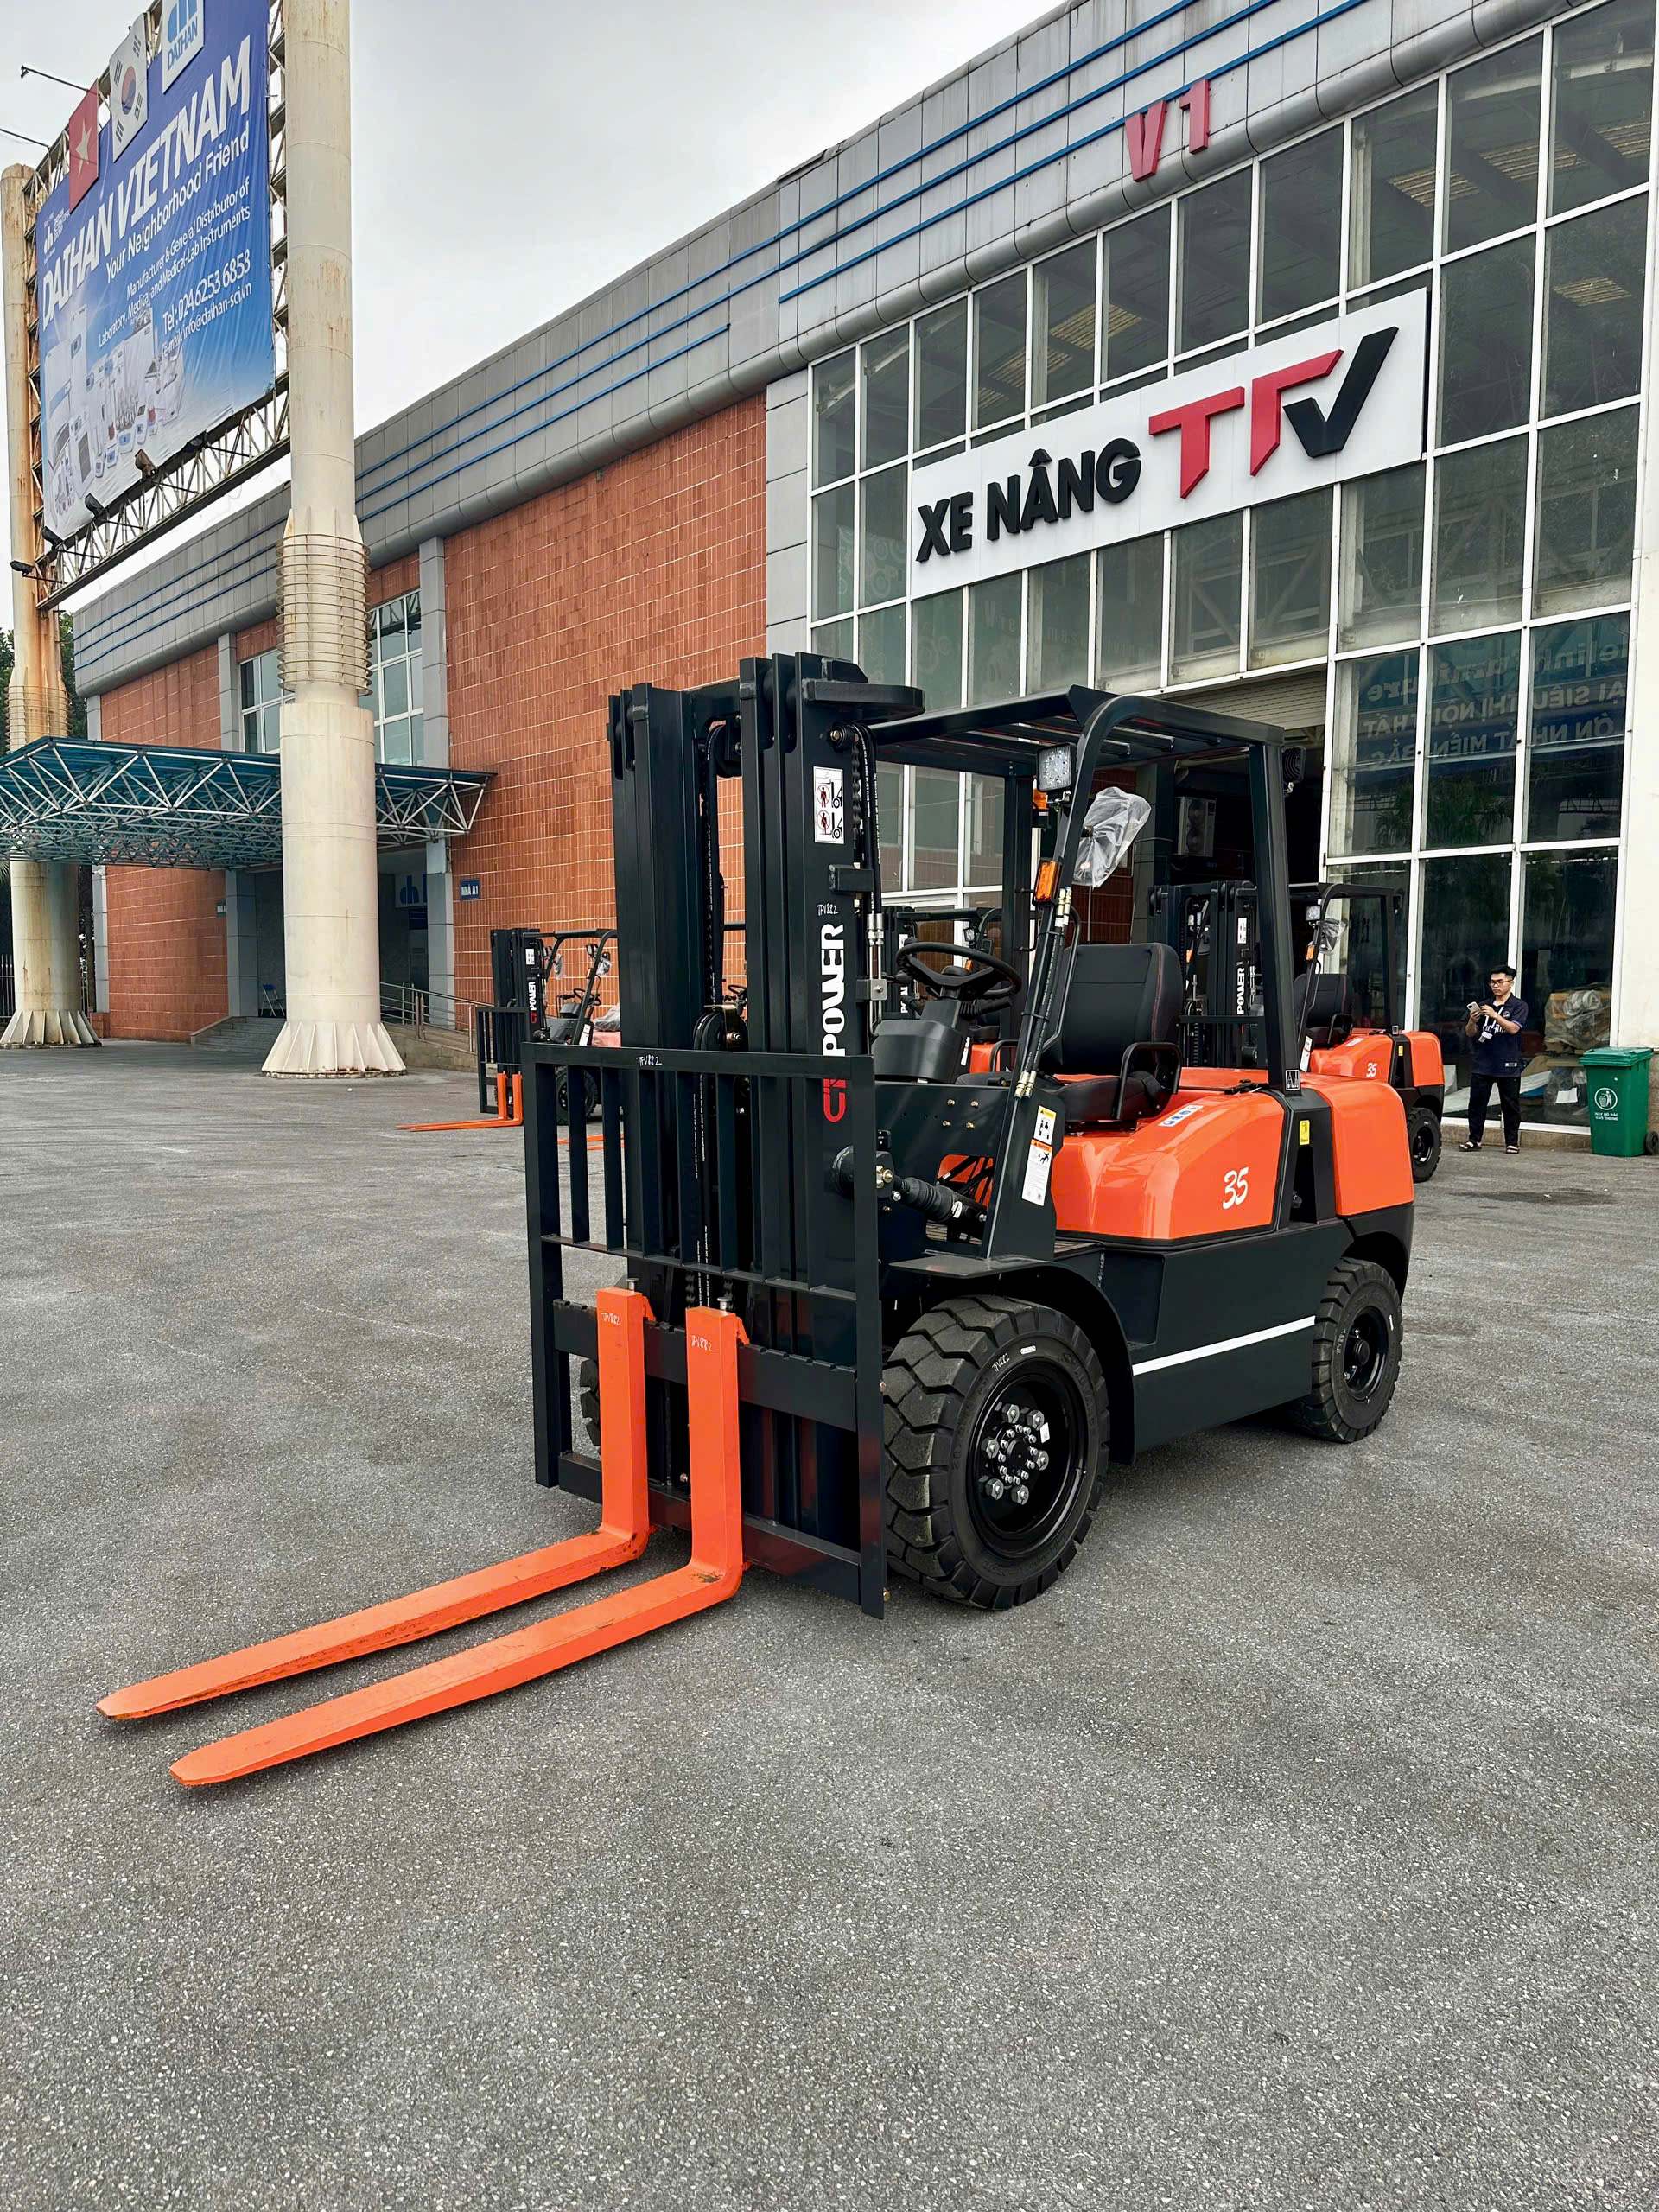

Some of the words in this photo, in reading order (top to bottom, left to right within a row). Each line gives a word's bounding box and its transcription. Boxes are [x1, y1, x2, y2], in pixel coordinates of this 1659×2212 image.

[168, 16, 198, 71] DAIHAN
[1124, 79, 1211, 182] V1
[43, 192, 114, 333] DAIHAN
[118, 35, 251, 240] VIETNAM
[106, 248, 126, 283] Your
[128, 162, 201, 261] Neighborhood
[205, 120, 249, 182] Friend
[200, 206, 251, 251] Instruments
[127, 253, 165, 300] Manufacturer
[170, 219, 196, 256] General
[196, 189, 238, 234] Distributor
[238, 176, 250, 199] of
[223, 249, 251, 287] 6858
[916, 491, 973, 563] XE
[987, 436, 1141, 541] NÂNG
[1148, 326, 1399, 499] TTV
[821, 924, 846, 1056] POWER
[1366, 1062, 1377, 1077] 35
[1223, 1166, 1249, 1210] 35
